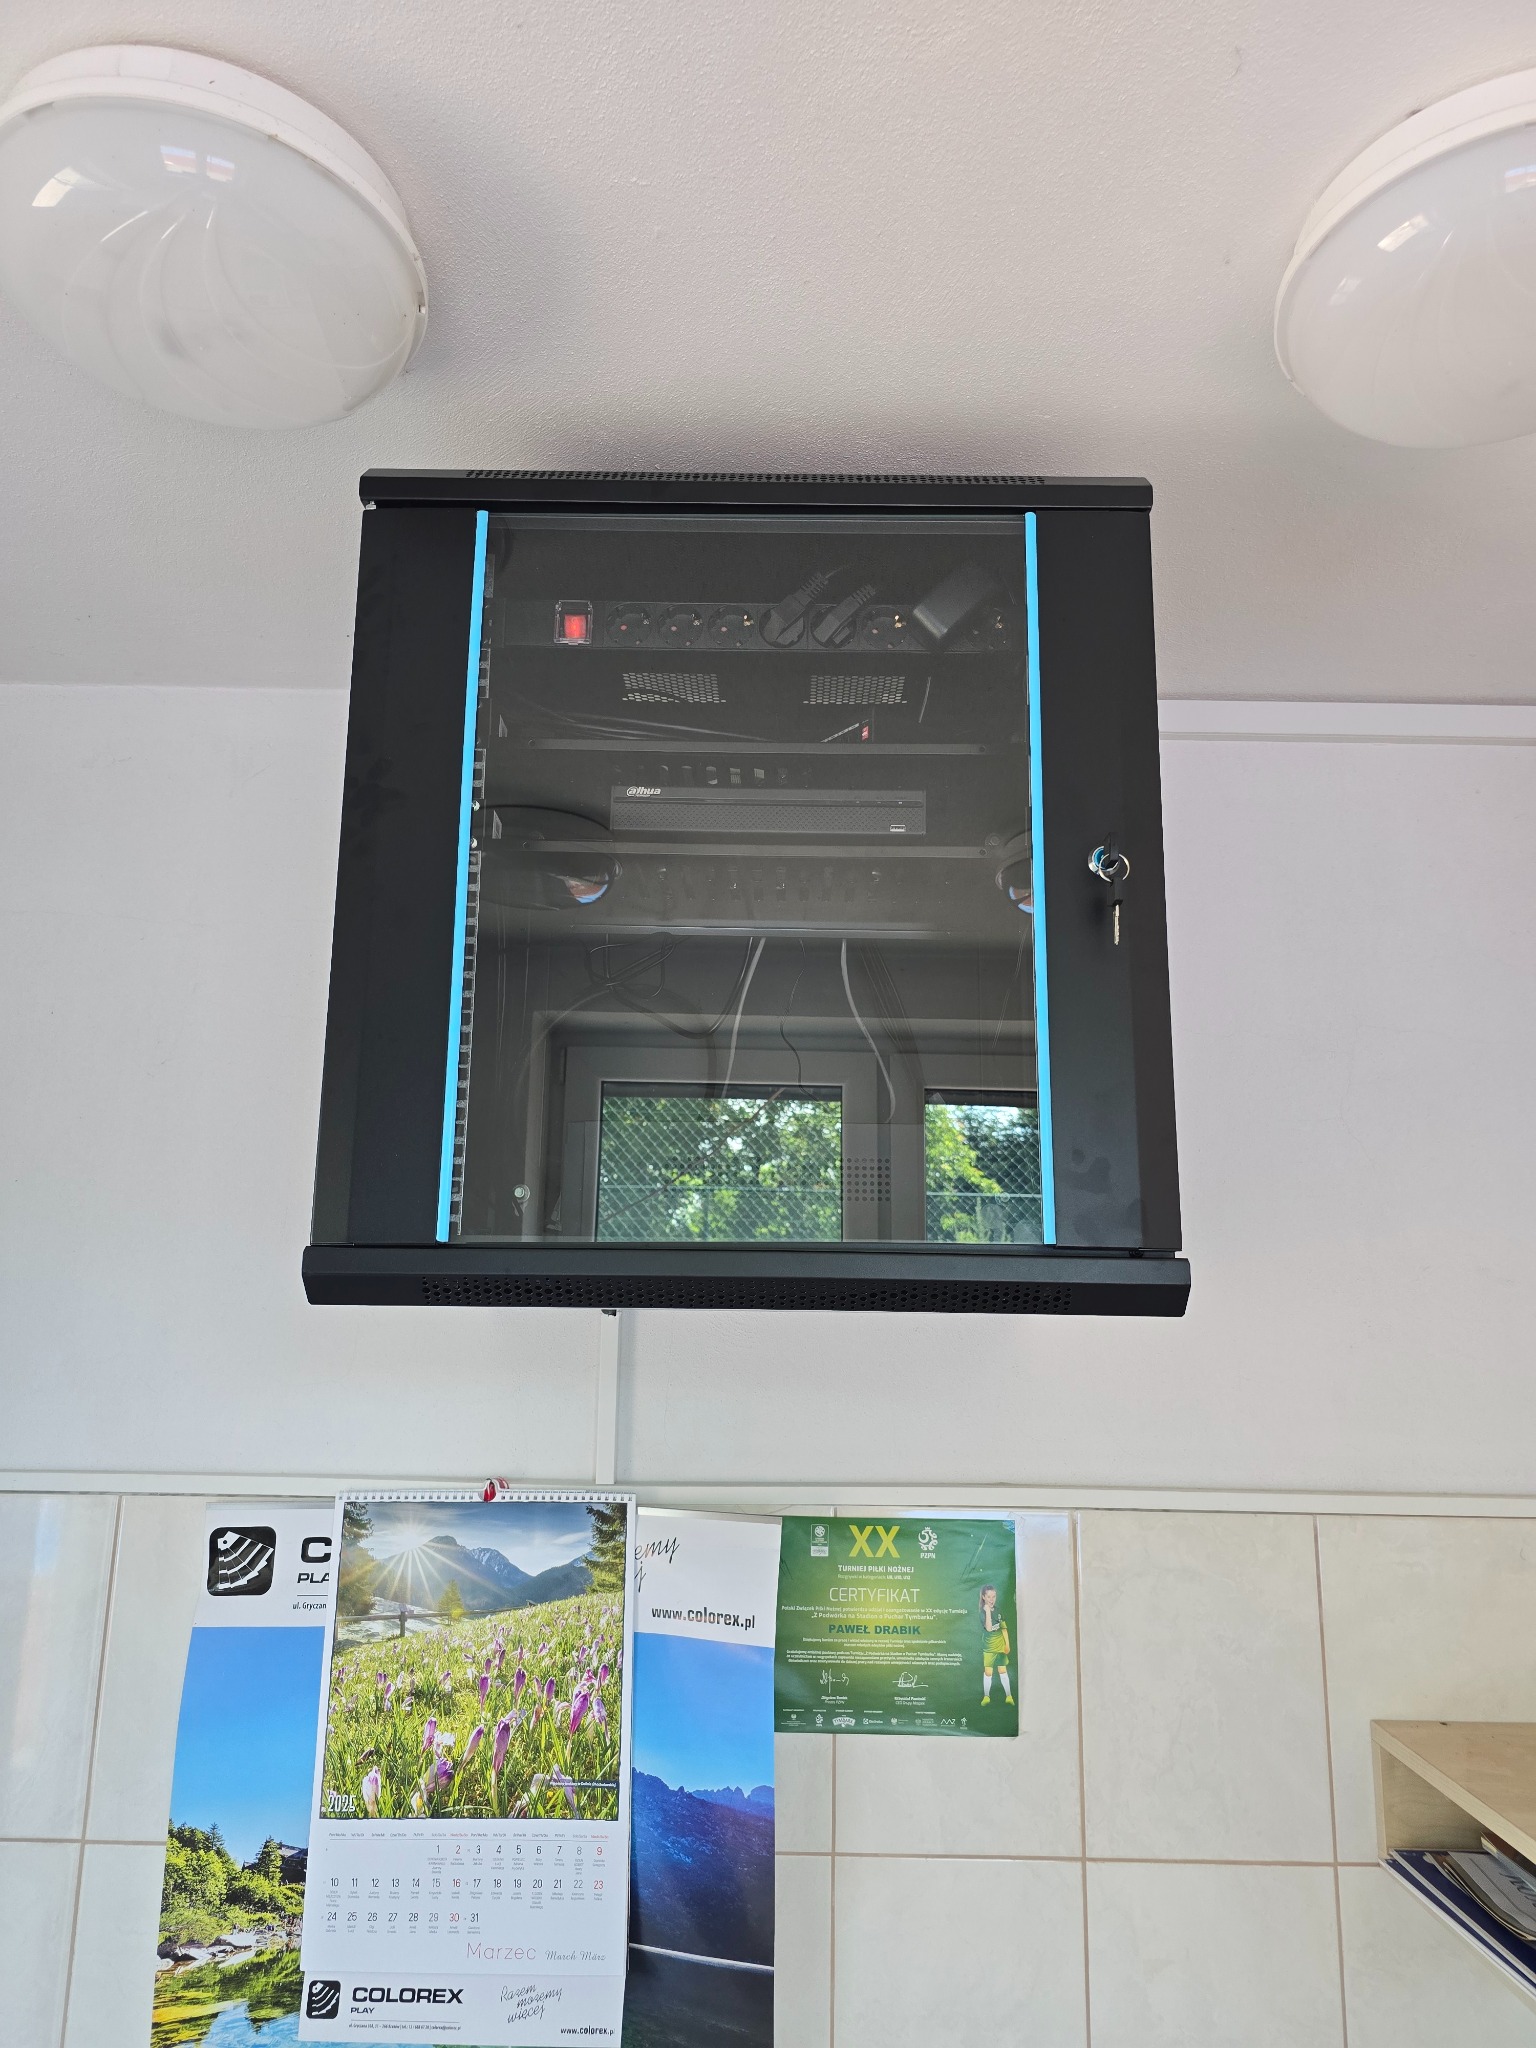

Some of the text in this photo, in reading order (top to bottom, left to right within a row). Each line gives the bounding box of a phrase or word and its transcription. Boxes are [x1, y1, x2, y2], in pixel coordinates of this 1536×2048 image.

[849, 1525, 900, 1558] XX
[635, 1537, 680, 1564] emy
[888, 1565, 914, 1573] NOŻNEJ
[297, 1573, 329, 1583] PLA
[829, 1588, 920, 1602] CERTYFIKAT
[302, 1602, 326, 1611] Gryczan
[652, 1607, 755, 1631] www.colorex.pl
[829, 1624, 921, 1635] PAWEŁ DRABIK
[328, 1795, 357, 1812] 2025
[436, 1845, 603, 1856] 1 2 3 4 5 6 7 8 9
[331, 1878, 604, 1890] 10 11 12 13 14 15 16 17 18 19 20 21 22 23
[327, 1912, 479, 1922] 24 25 26 27 28 29 30 31
[466, 1942, 606, 1961] Marzec March März
[352, 1987, 463, 2004] COLOREX
[500, 1984, 537, 2002] Razem
[507, 2003, 545, 2023] więcej
[560, 2025, 615, 2036] www.colorex.pl
